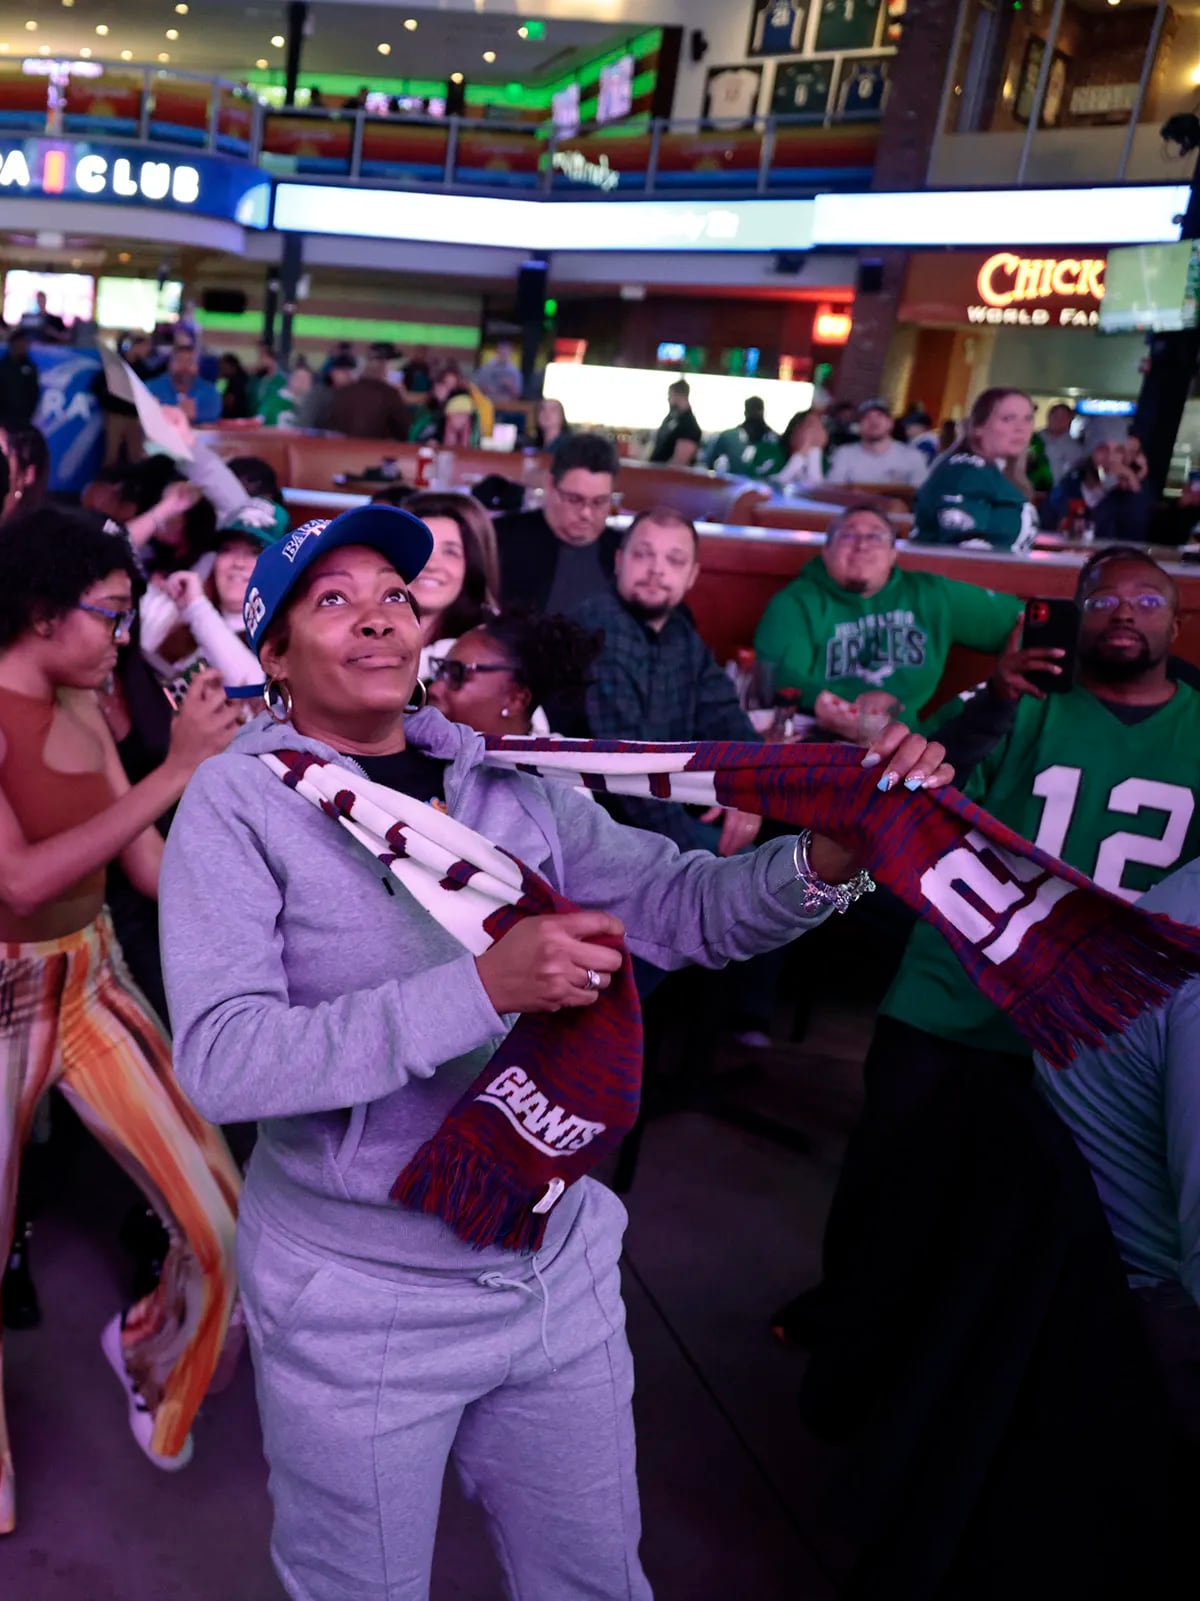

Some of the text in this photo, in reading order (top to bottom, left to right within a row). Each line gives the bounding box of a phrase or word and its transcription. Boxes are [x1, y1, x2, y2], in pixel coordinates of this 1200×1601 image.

[75, 154, 199, 204] CLUB
[967, 304, 1051, 326] WORLD
[824, 627, 927, 681] EALES
[1032, 764, 1196, 903] 12
[484, 1065, 607, 1150] GIANTS
